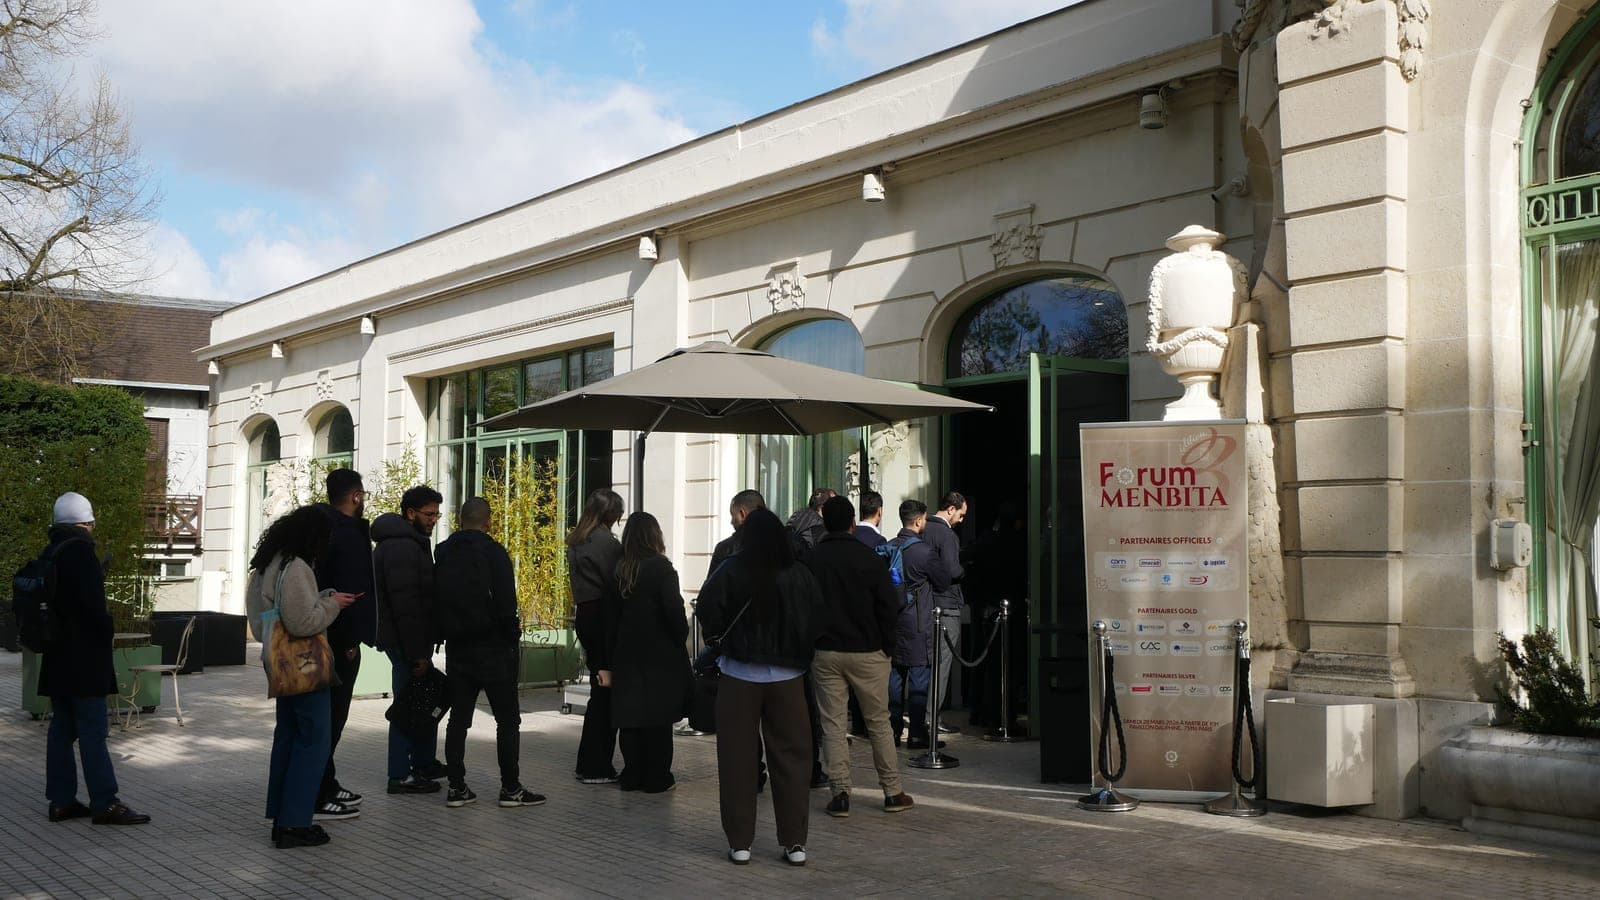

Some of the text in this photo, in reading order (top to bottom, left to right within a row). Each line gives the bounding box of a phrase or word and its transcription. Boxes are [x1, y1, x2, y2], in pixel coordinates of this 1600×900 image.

[1100, 486, 1229, 508] MENBITA
[1120, 536, 1212, 545] PARTENAIRES OFFICIELS
